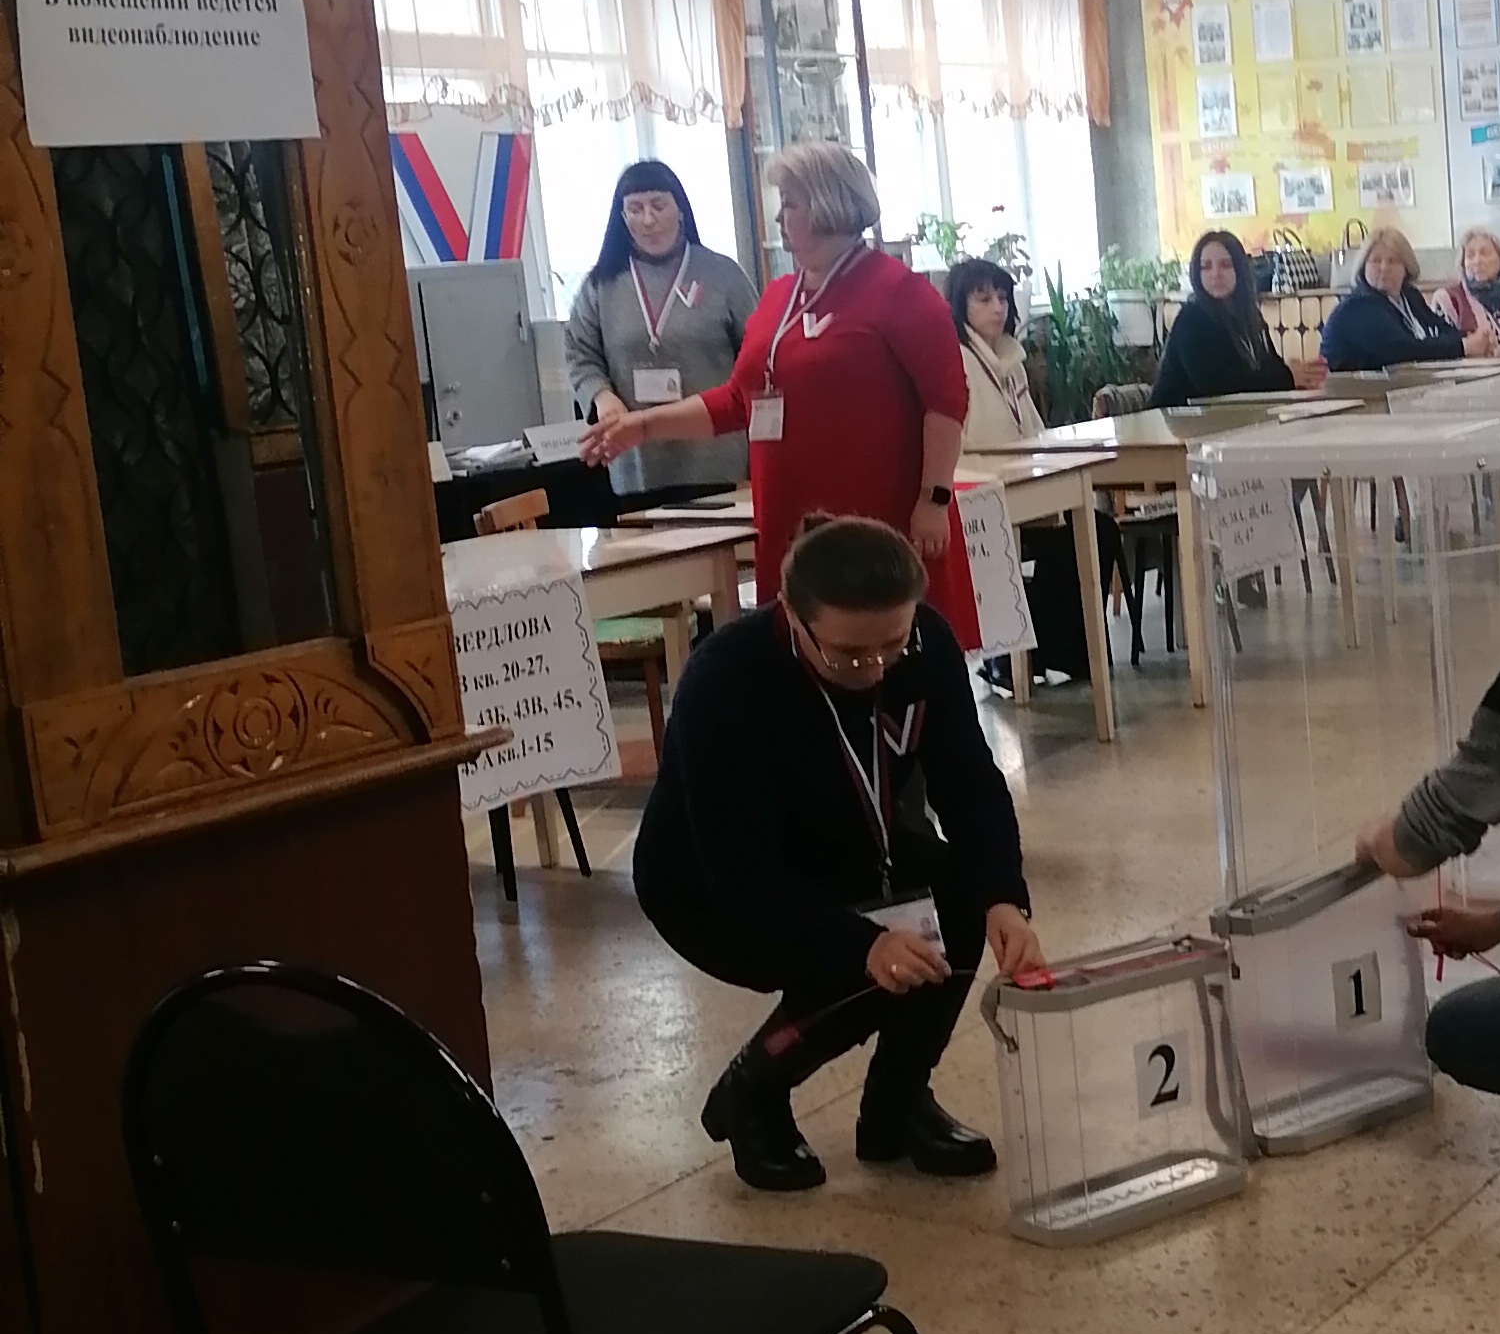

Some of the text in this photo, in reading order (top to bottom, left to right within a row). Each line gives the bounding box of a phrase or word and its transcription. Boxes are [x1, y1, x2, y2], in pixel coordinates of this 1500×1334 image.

[68, 22, 261, 48] видеонаблюдение
[1350, 969, 1367, 1017] 1
[1148, 1043, 1179, 1107] 2
